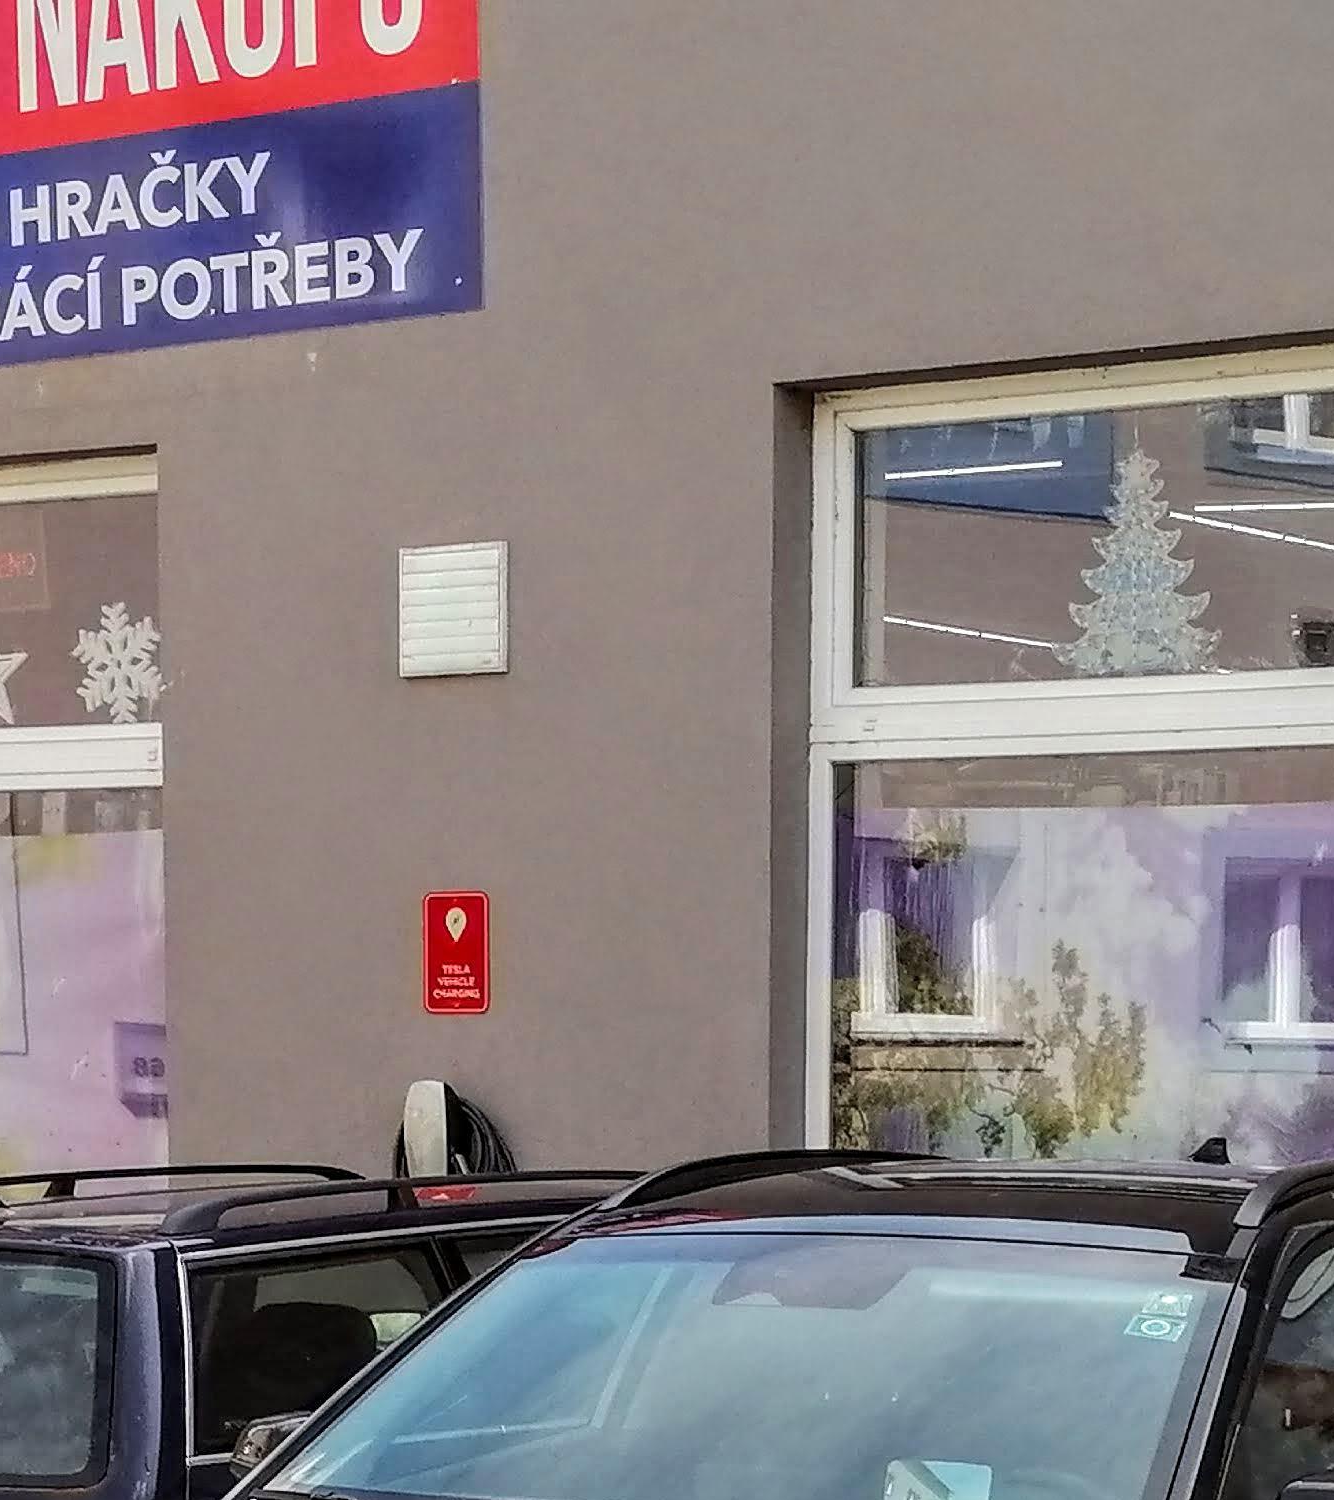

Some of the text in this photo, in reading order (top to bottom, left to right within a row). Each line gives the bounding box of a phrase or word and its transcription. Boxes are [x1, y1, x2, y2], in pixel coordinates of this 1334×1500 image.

[8, 149, 271, 248] HRAČKY
[121, 229, 424, 326] POTŘEBY
[437, 976, 476, 987] VEHICLE
[442, 964, 470, 975] TESLA
